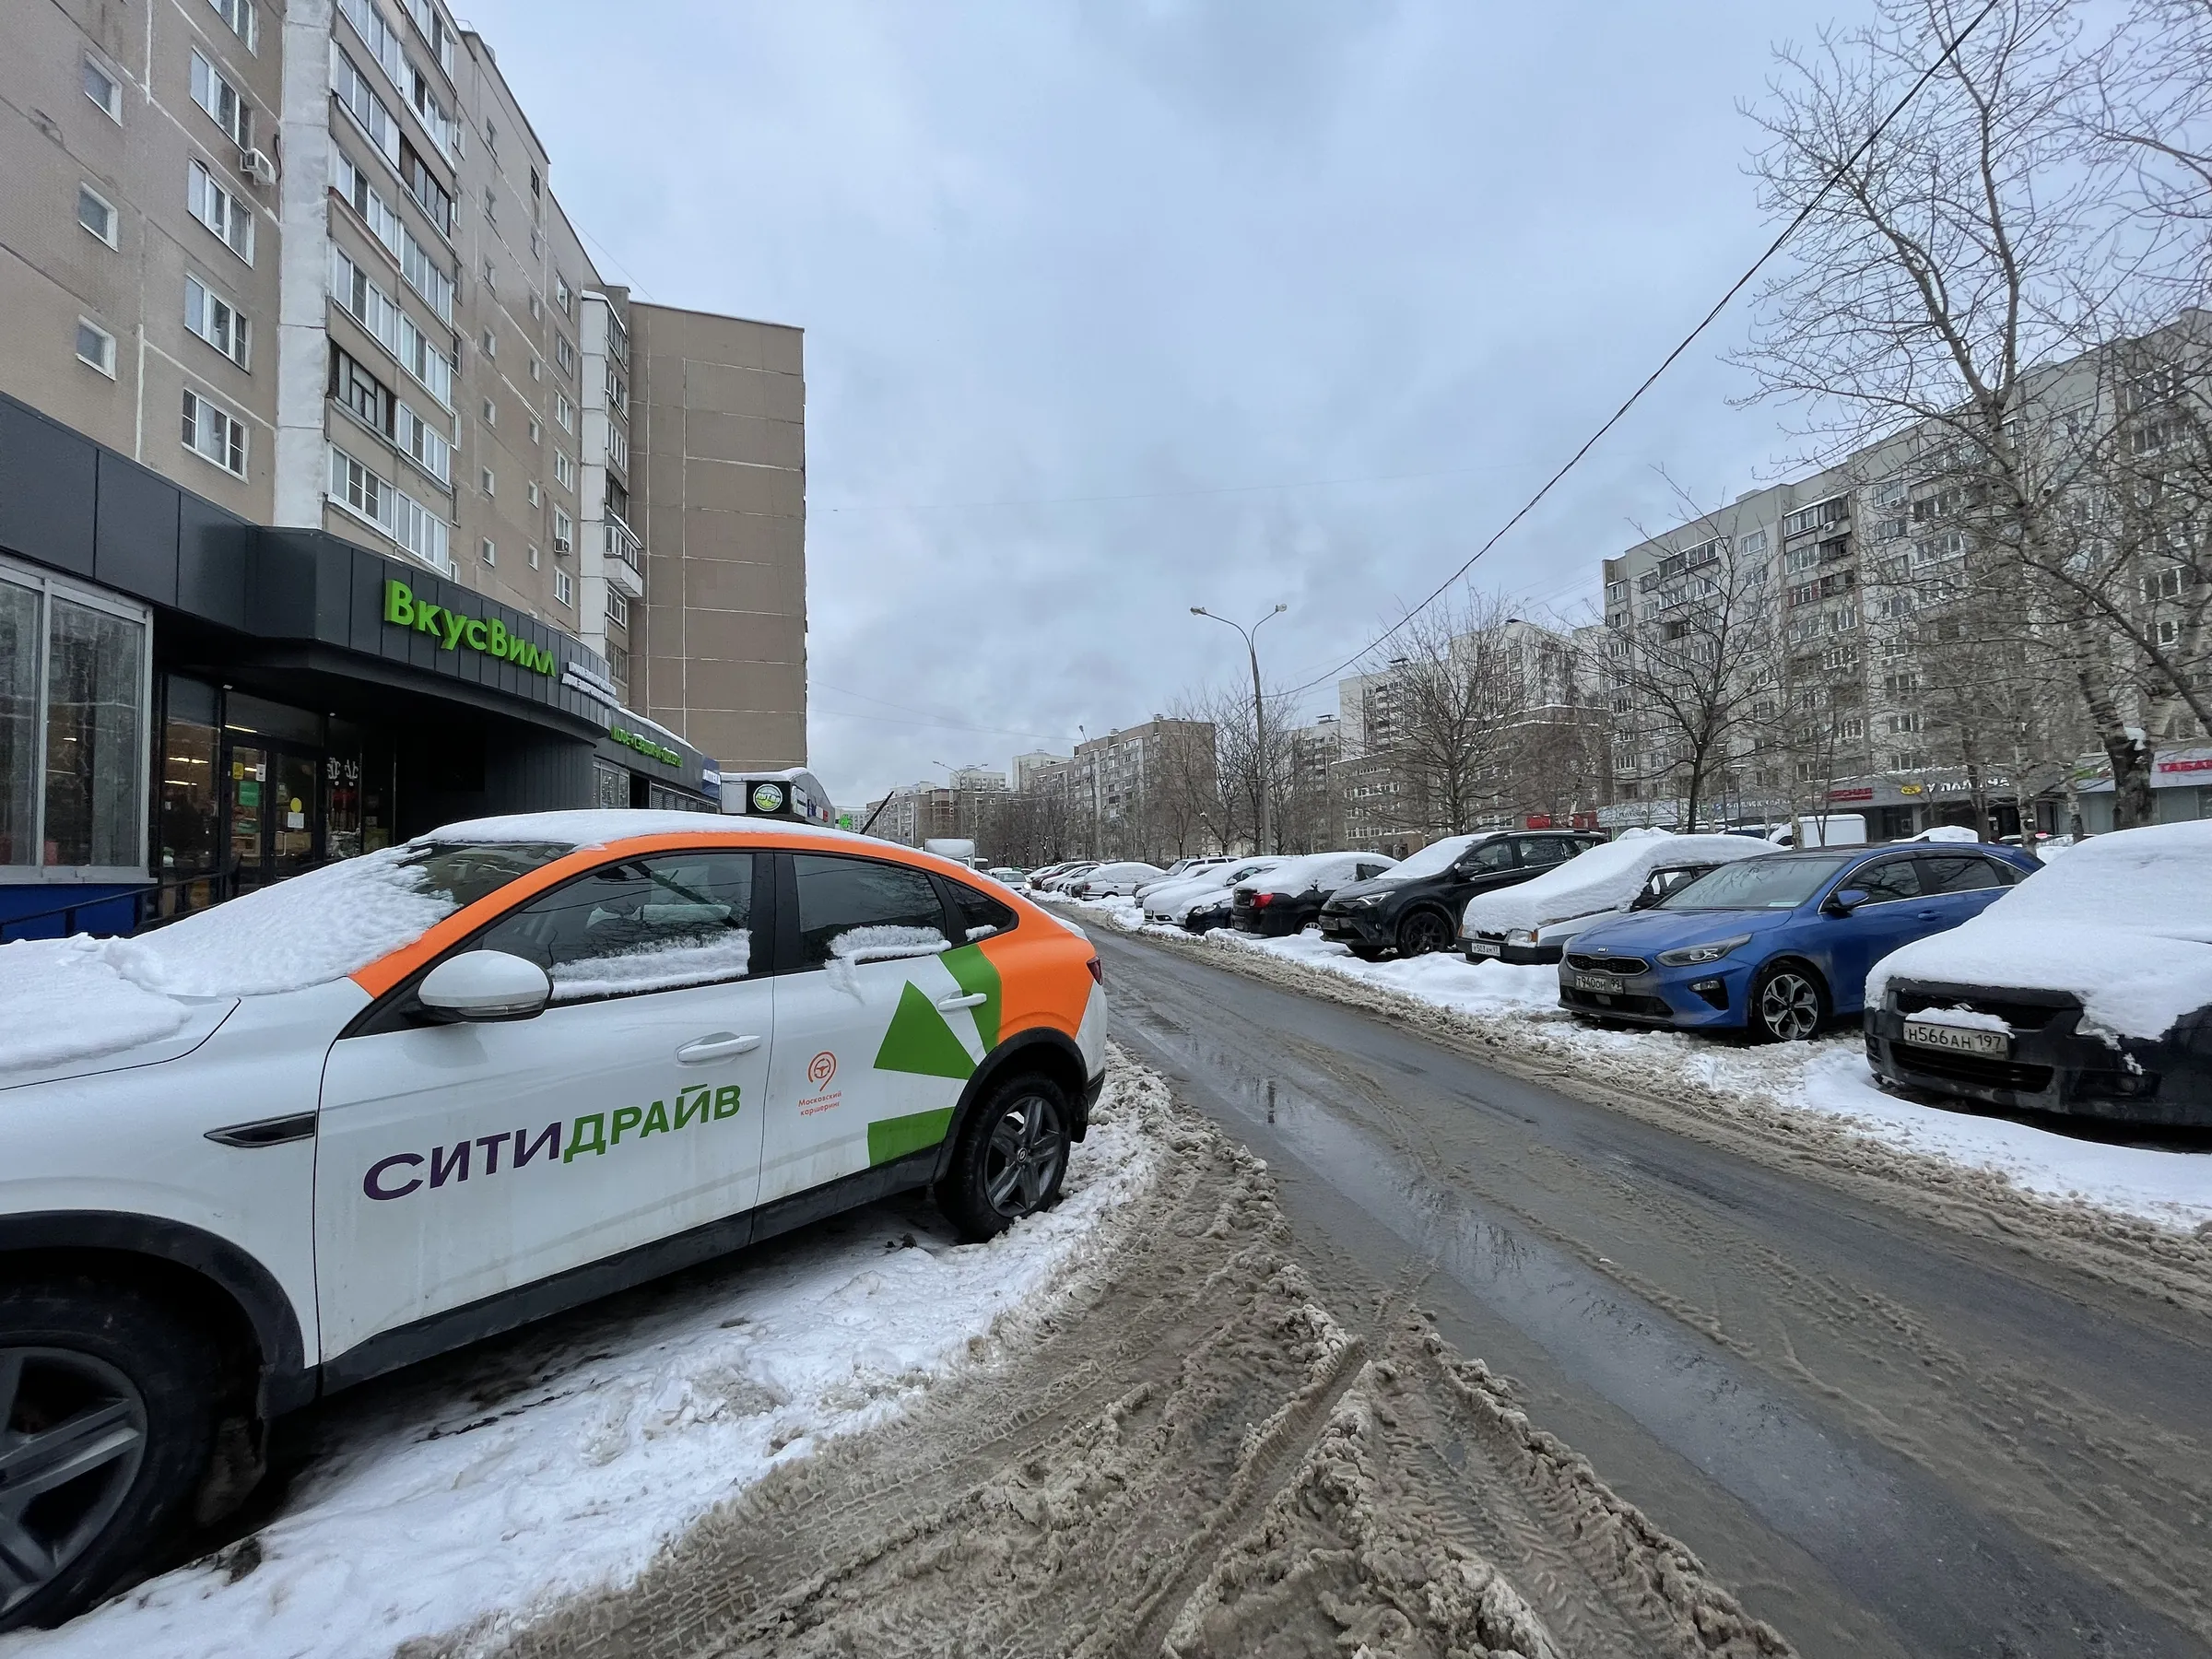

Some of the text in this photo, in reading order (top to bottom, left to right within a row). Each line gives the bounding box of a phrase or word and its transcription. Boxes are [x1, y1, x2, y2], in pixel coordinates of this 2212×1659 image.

[385, 579, 557, 677] ВкусВилл
[1909, 1027, 2002, 1050] Н566АН 197
[798, 1090, 842, 1107] Московский
[800, 1101, 840, 1116] каршеринг
[363, 1083, 742, 1201] СИТИДРАЙВ
